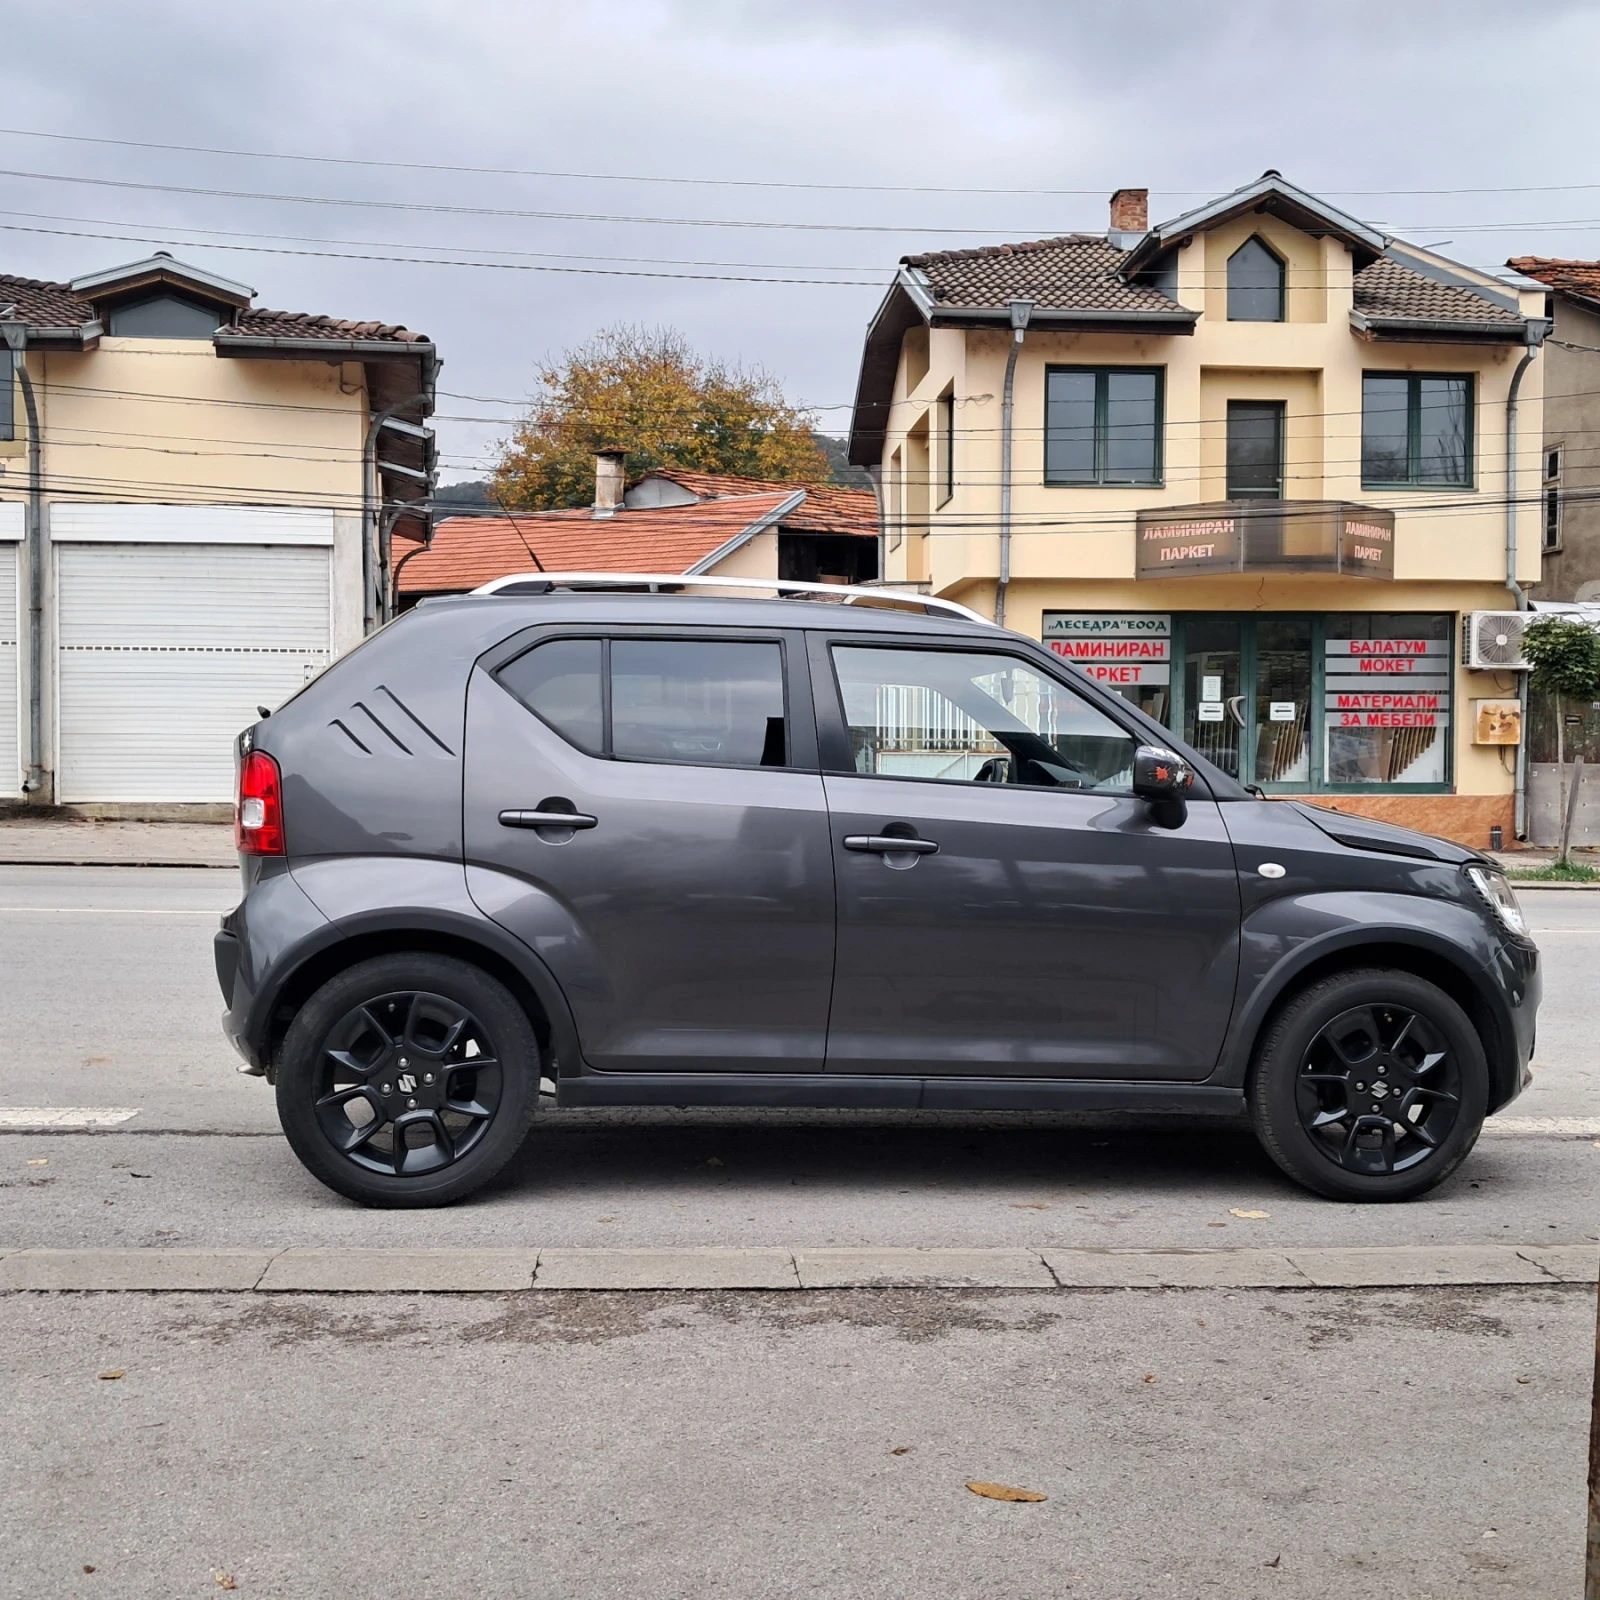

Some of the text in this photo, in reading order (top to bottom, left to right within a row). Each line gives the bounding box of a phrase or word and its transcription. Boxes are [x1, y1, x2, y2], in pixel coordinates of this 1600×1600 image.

[1143, 520, 1235, 540] ЛАМИНИРАН
[1345, 521, 1391, 541] ЛАМИНИРАН
[1160, 544, 1215, 561] ПАРКЕТ
[1354, 545, 1382, 562] ПАРКЕТ
[1350, 640, 1426, 654] БАЛАТУМ
[1359, 659, 1415, 672] МОКЕТ
[1086, 667, 1142, 682] РКЕТ
[1337, 695, 1439, 708] МАТЕРИАЛИ
[1340, 713, 1436, 726] ЗА МЕБЕЛИ
